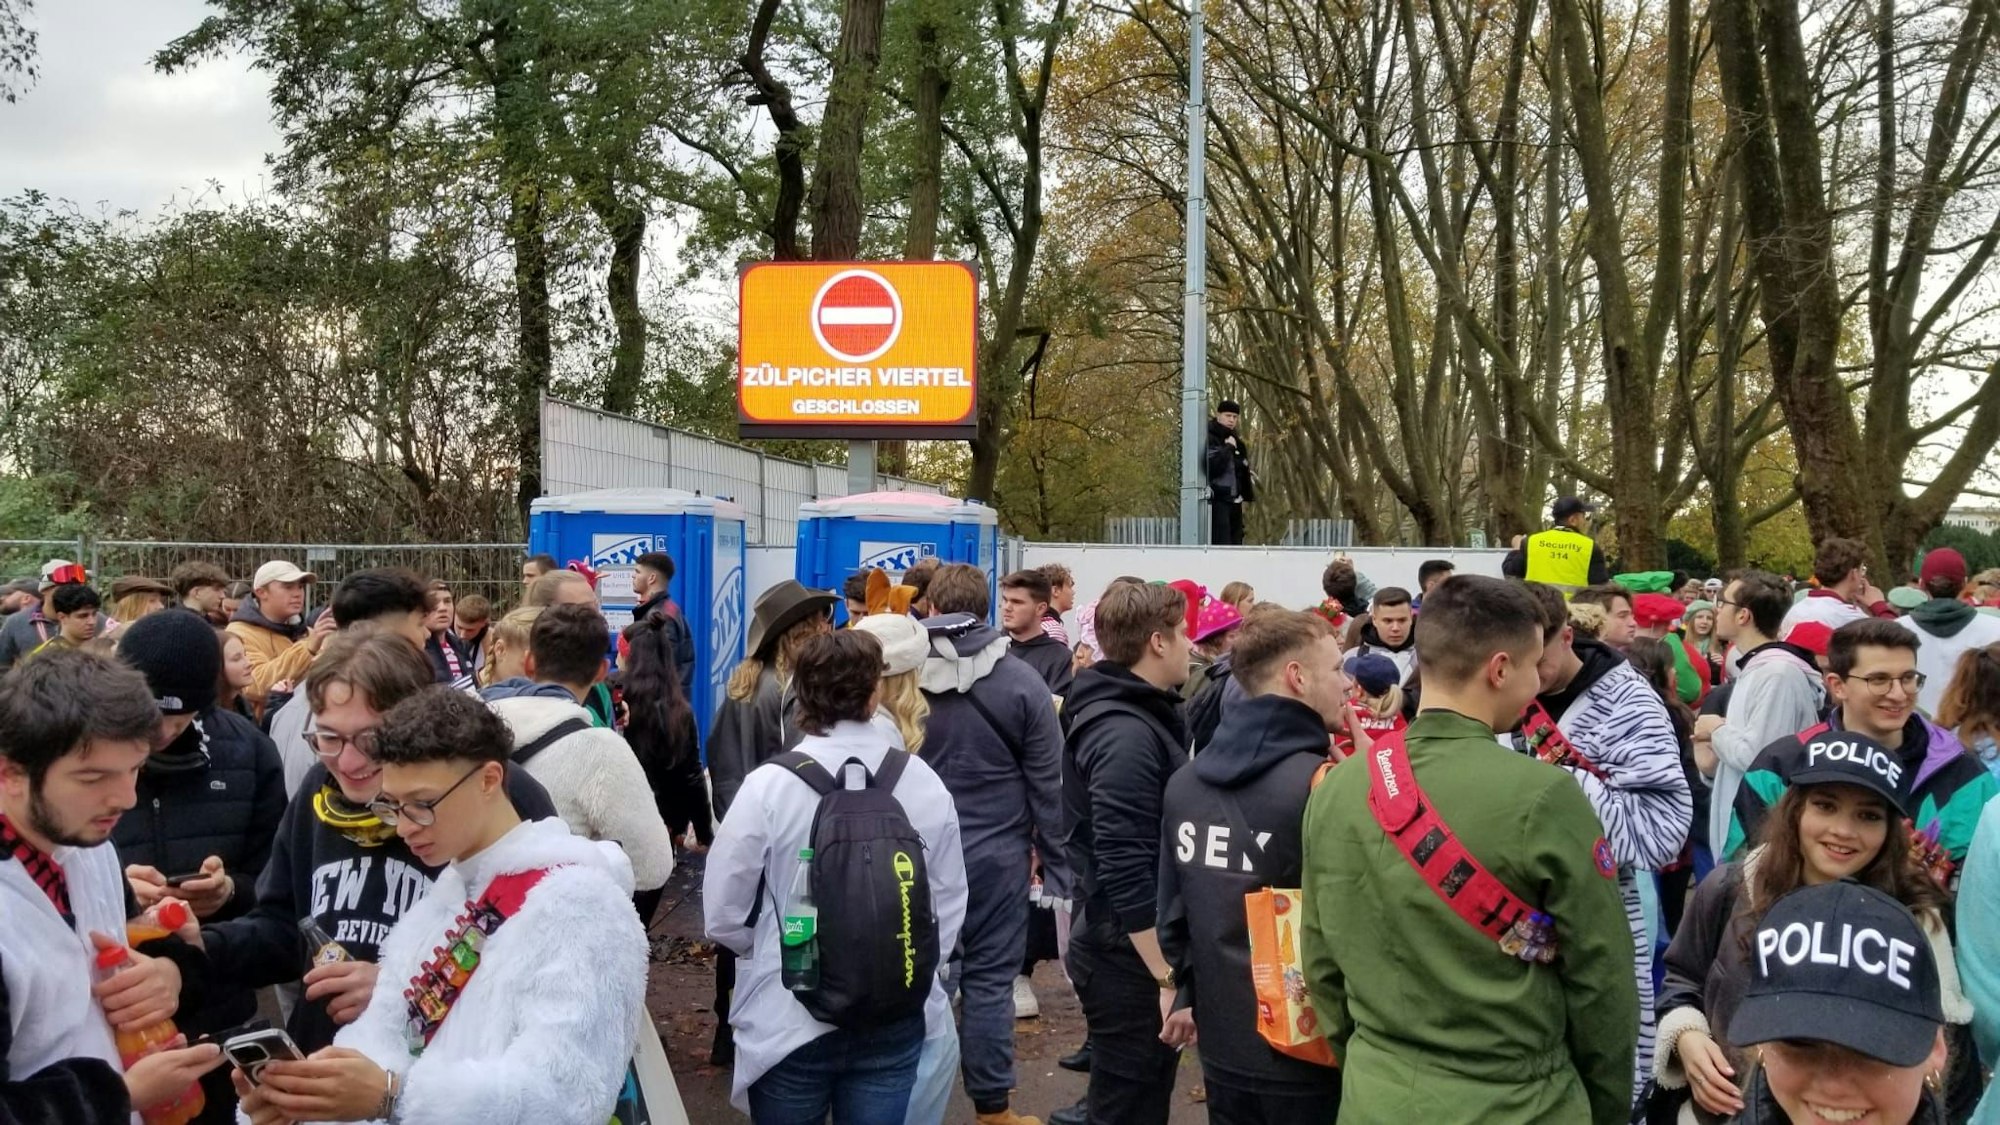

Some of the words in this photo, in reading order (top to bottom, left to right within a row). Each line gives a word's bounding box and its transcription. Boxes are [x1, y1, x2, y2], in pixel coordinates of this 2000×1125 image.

[742, 363, 871, 387] ZÜLPICHER
[877, 367, 972, 387] VIERTEL
[792, 399, 920, 414] GESCHLOSSEN
[1539, 540, 1582, 552] Security
[1809, 741, 1902, 789] POLICE
[311, 856, 372, 919] EW
[334, 919, 391, 945] REVIE
[893, 851, 914, 988] Champion
[1757, 921, 1916, 990] POLICE
